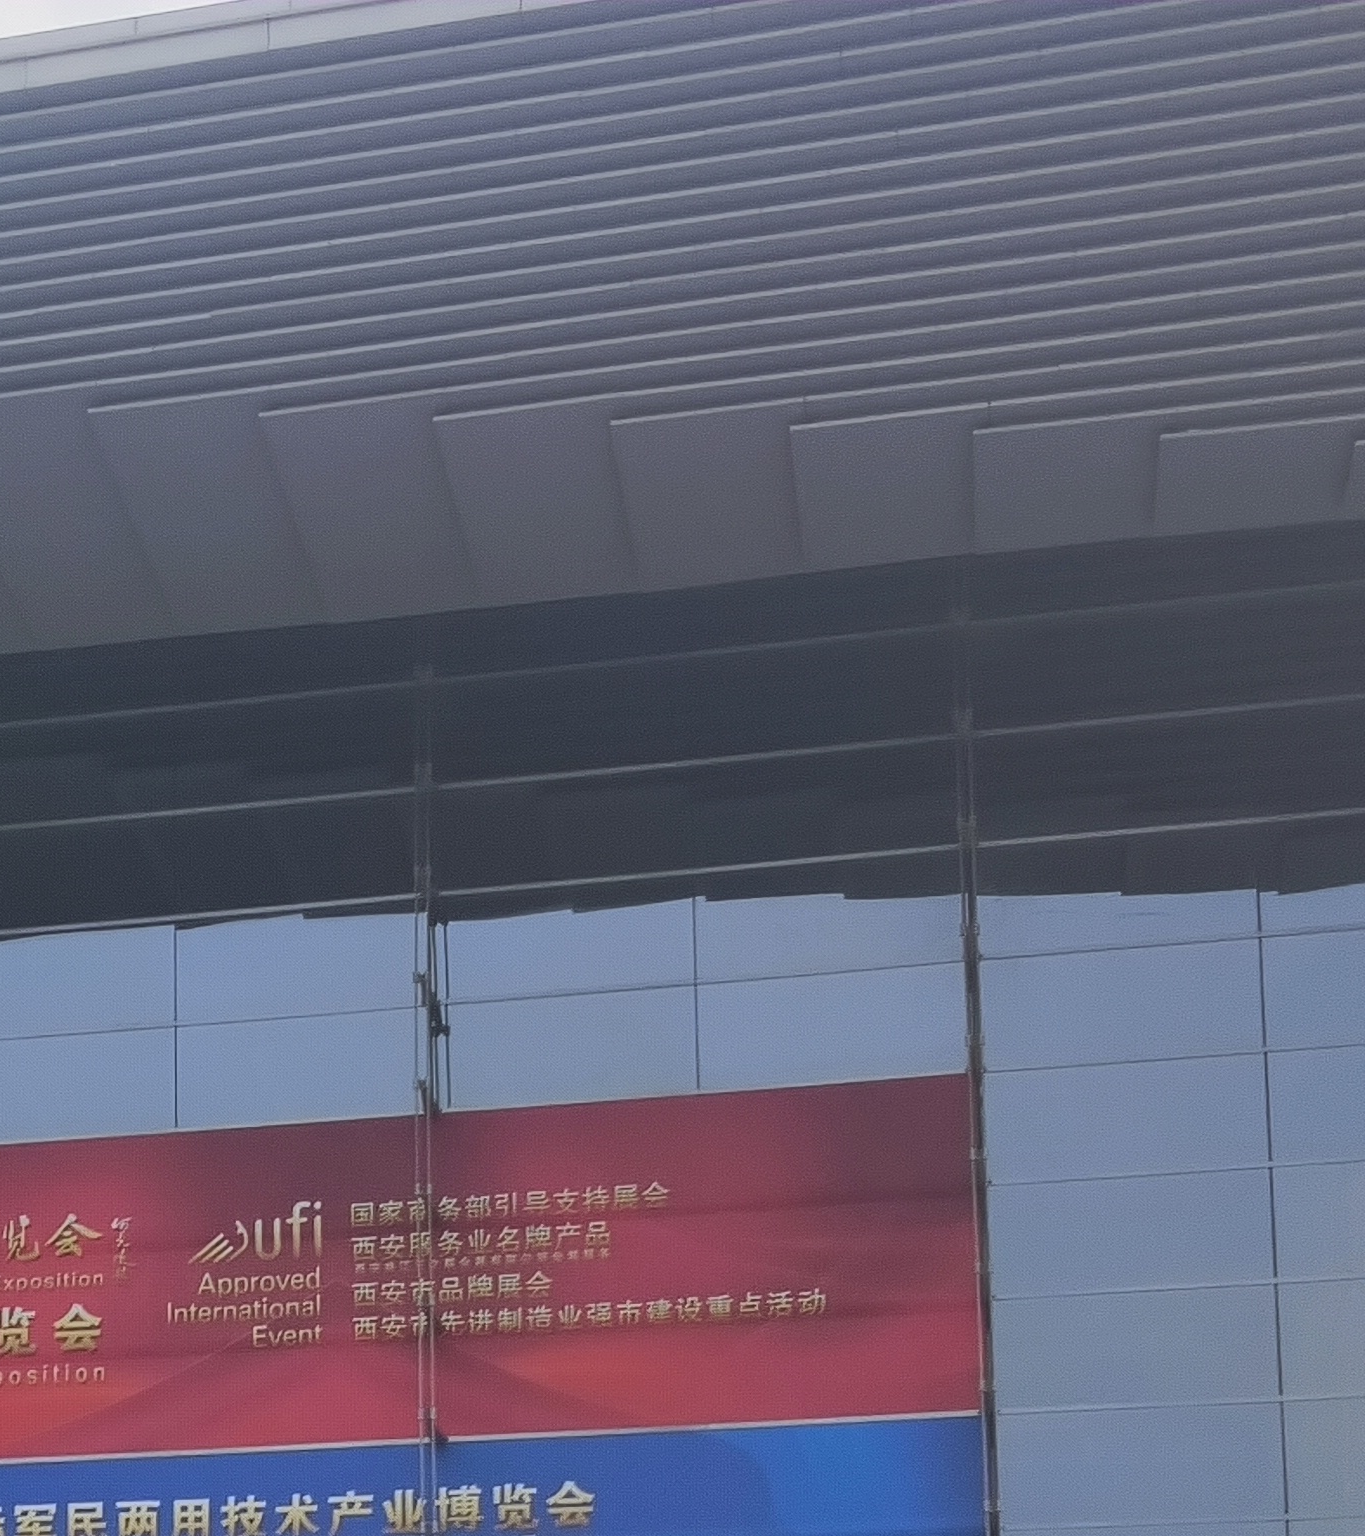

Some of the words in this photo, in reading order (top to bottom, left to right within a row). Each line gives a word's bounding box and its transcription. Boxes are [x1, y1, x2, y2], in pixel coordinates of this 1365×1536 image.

[254, 1200, 322, 1261] ufi
[350, 1221, 610, 1260] 西安服务业名牌产品
[197, 1265, 320, 1296] Approved
[351, 1270, 553, 1306] 西安市品牌展会
[167, 1294, 321, 1323] International
[351, 1288, 827, 1340] 西安市先进制造业强市建设重点活动
[252, 1324, 323, 1348] Event
